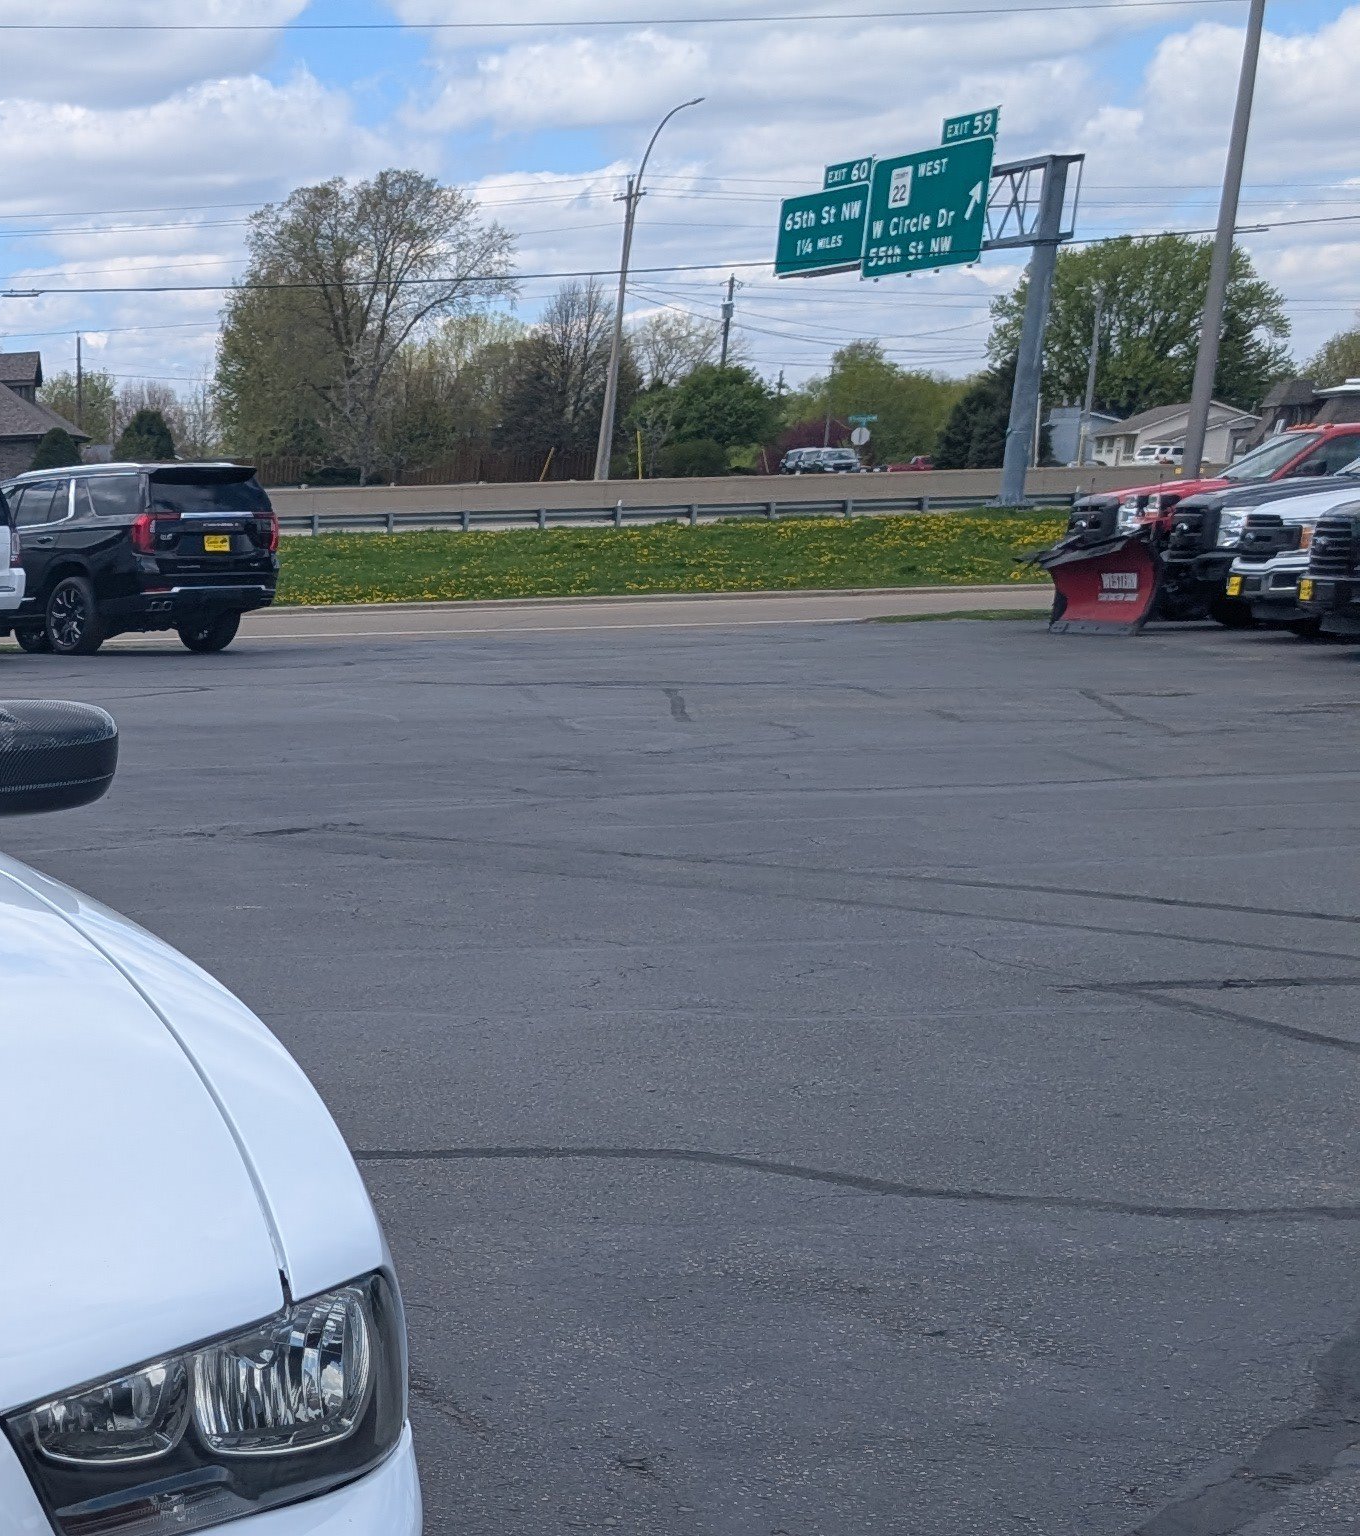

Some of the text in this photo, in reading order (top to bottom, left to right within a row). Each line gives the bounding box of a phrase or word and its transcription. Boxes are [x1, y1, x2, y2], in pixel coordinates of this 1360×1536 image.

[946, 112, 994, 139] EXIT 59
[827, 161, 869, 184] EXIT 60
[917, 157, 949, 178] WEST
[891, 183, 907, 203] 22
[784, 199, 862, 232] 65th St NW
[872, 207, 956, 240] W Circle Dr
[816, 234, 843, 251] MILES
[867, 235, 953, 267] 55th St NW
